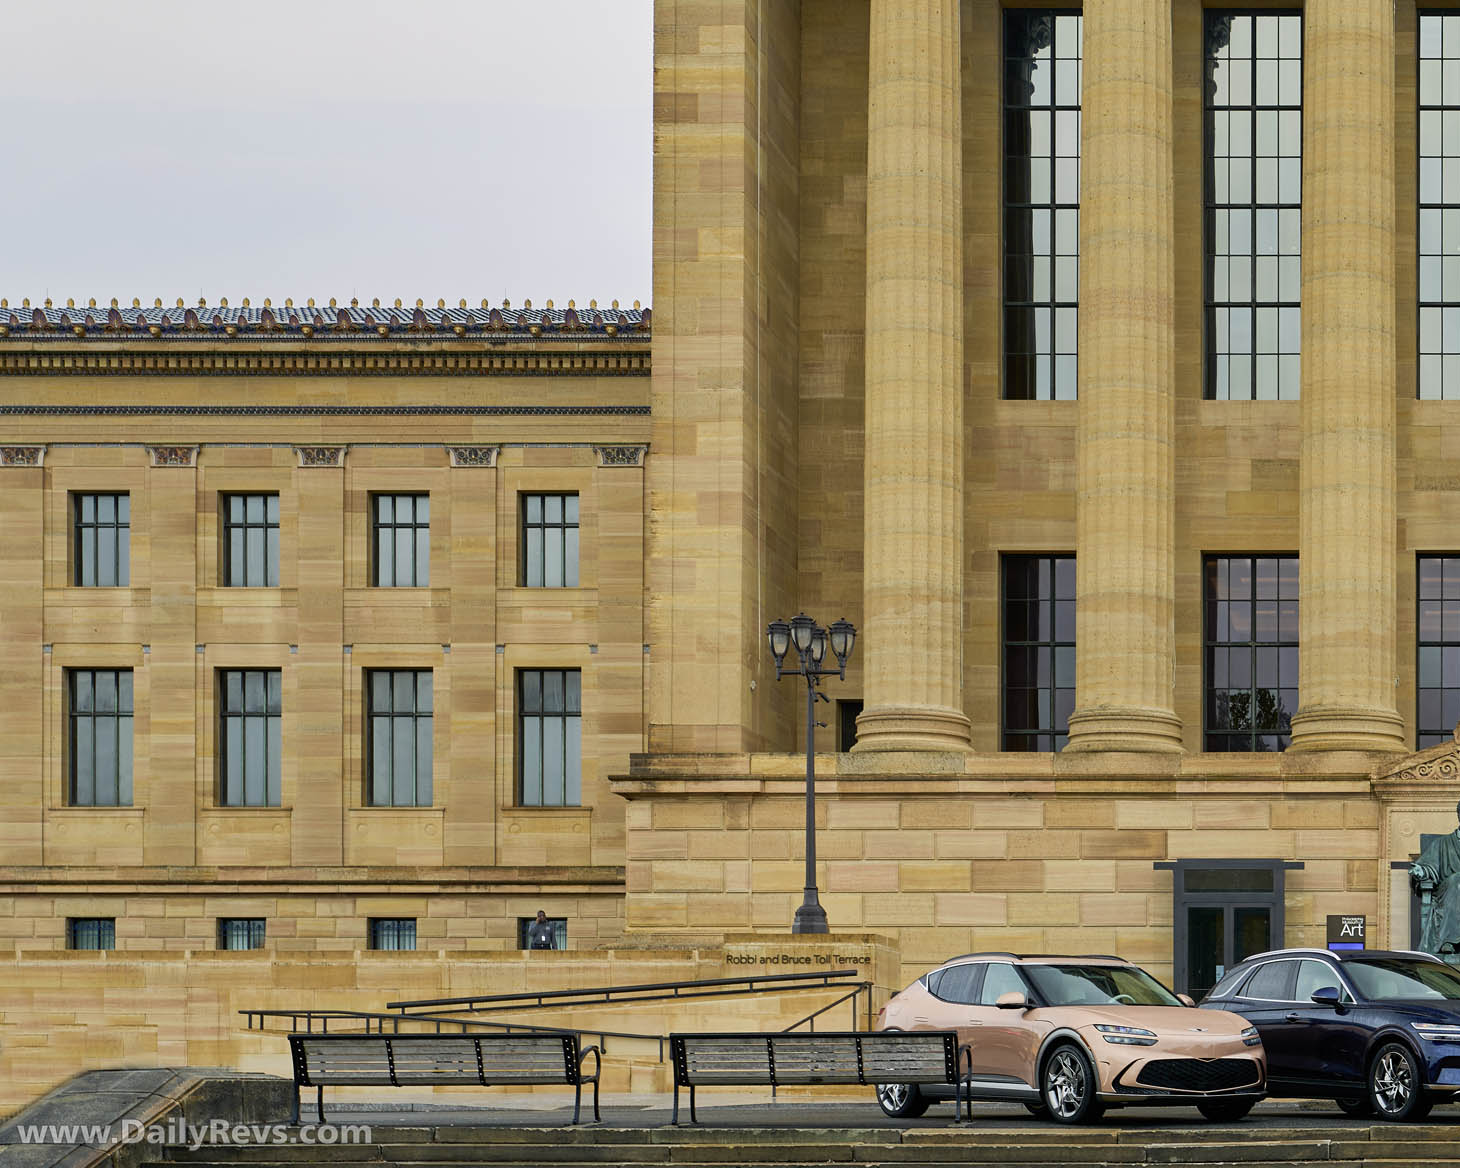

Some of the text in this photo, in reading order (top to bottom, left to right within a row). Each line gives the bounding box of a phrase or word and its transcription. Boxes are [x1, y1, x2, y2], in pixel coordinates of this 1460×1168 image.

[1340, 923, 1364, 937] Art
[726, 954, 871, 965] Robbi and Bruce Toll Terrace
